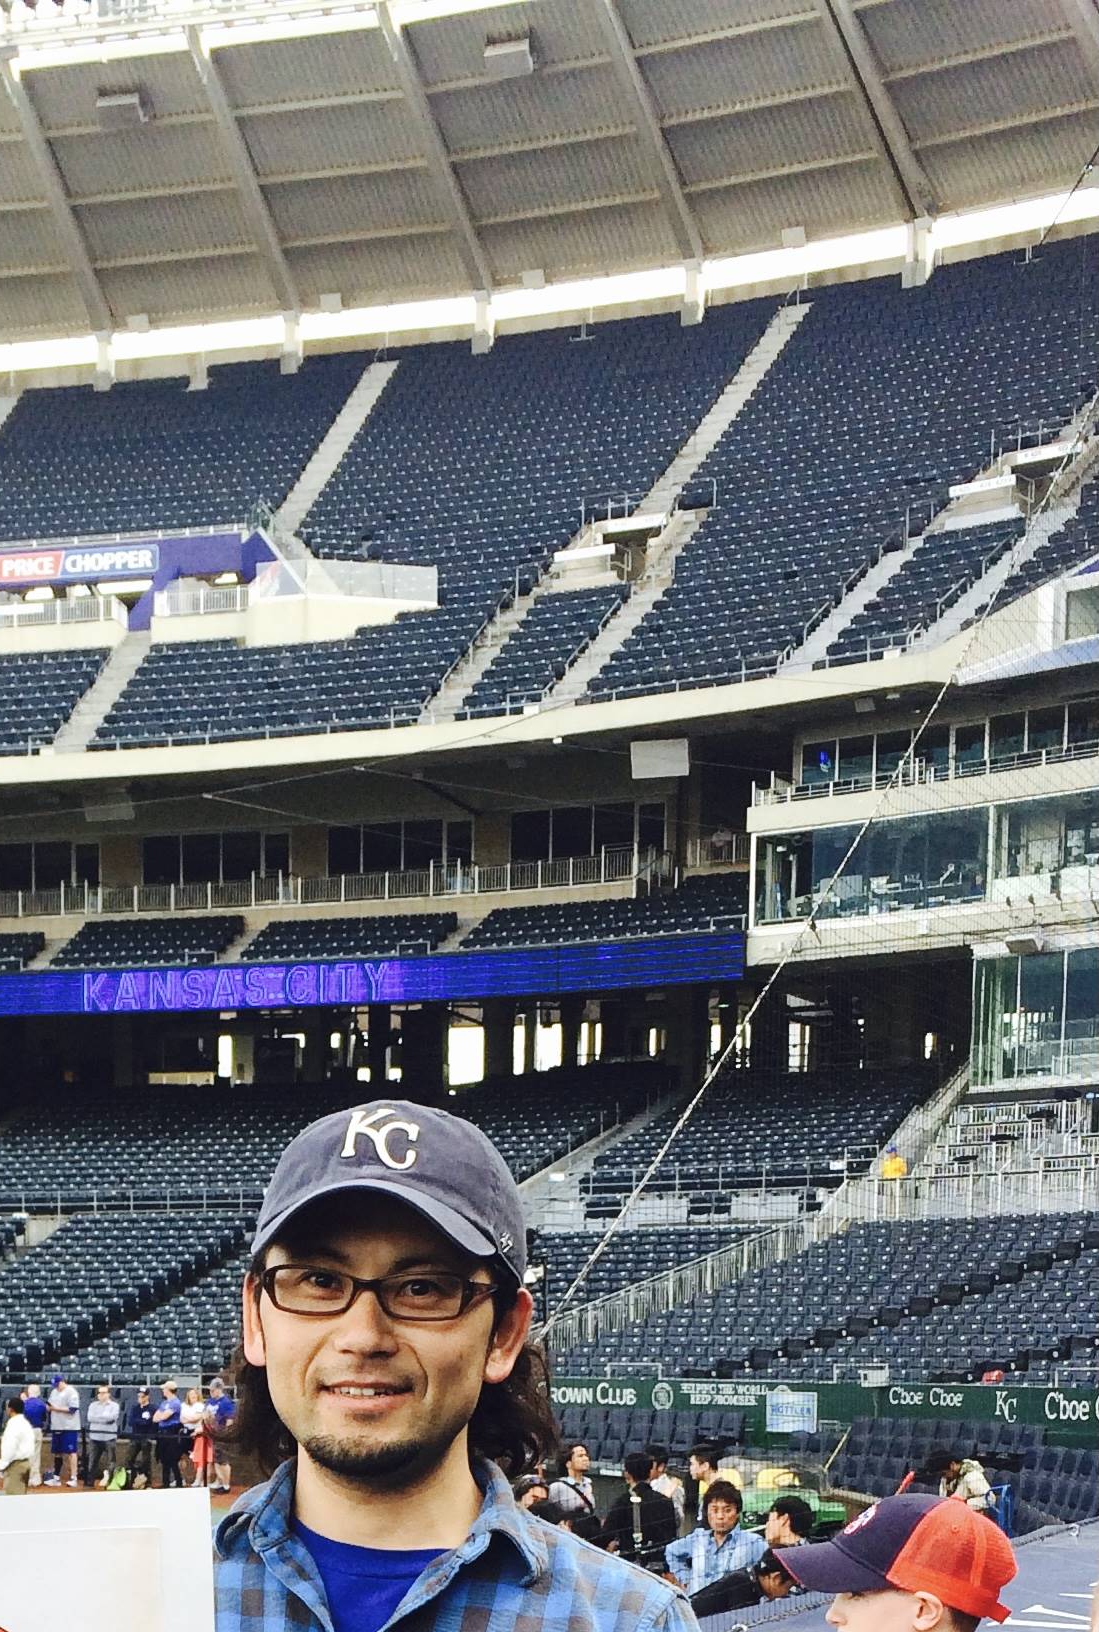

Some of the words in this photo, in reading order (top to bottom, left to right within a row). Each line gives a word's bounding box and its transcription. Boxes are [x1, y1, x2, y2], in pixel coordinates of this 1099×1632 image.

[2, 556, 55, 577] PRICE
[65, 549, 154, 573] CHOPPER
[82, 969, 273, 1012] KANSAS
[286, 960, 390, 1005] CITY
[340, 1107, 421, 1170] KC
[596, 1382, 637, 1405] CLUB
[690, 1394, 711, 1404] KEEP
[718, 1383, 735, 1394] THE
[736, 1384, 768, 1396] WORLD
[889, 1387, 925, 1405] Cboe
[930, 1388, 964, 1407] Cboe
[994, 1390, 1017, 1423] KC
[1045, 1391, 1091, 1421] Cboe
